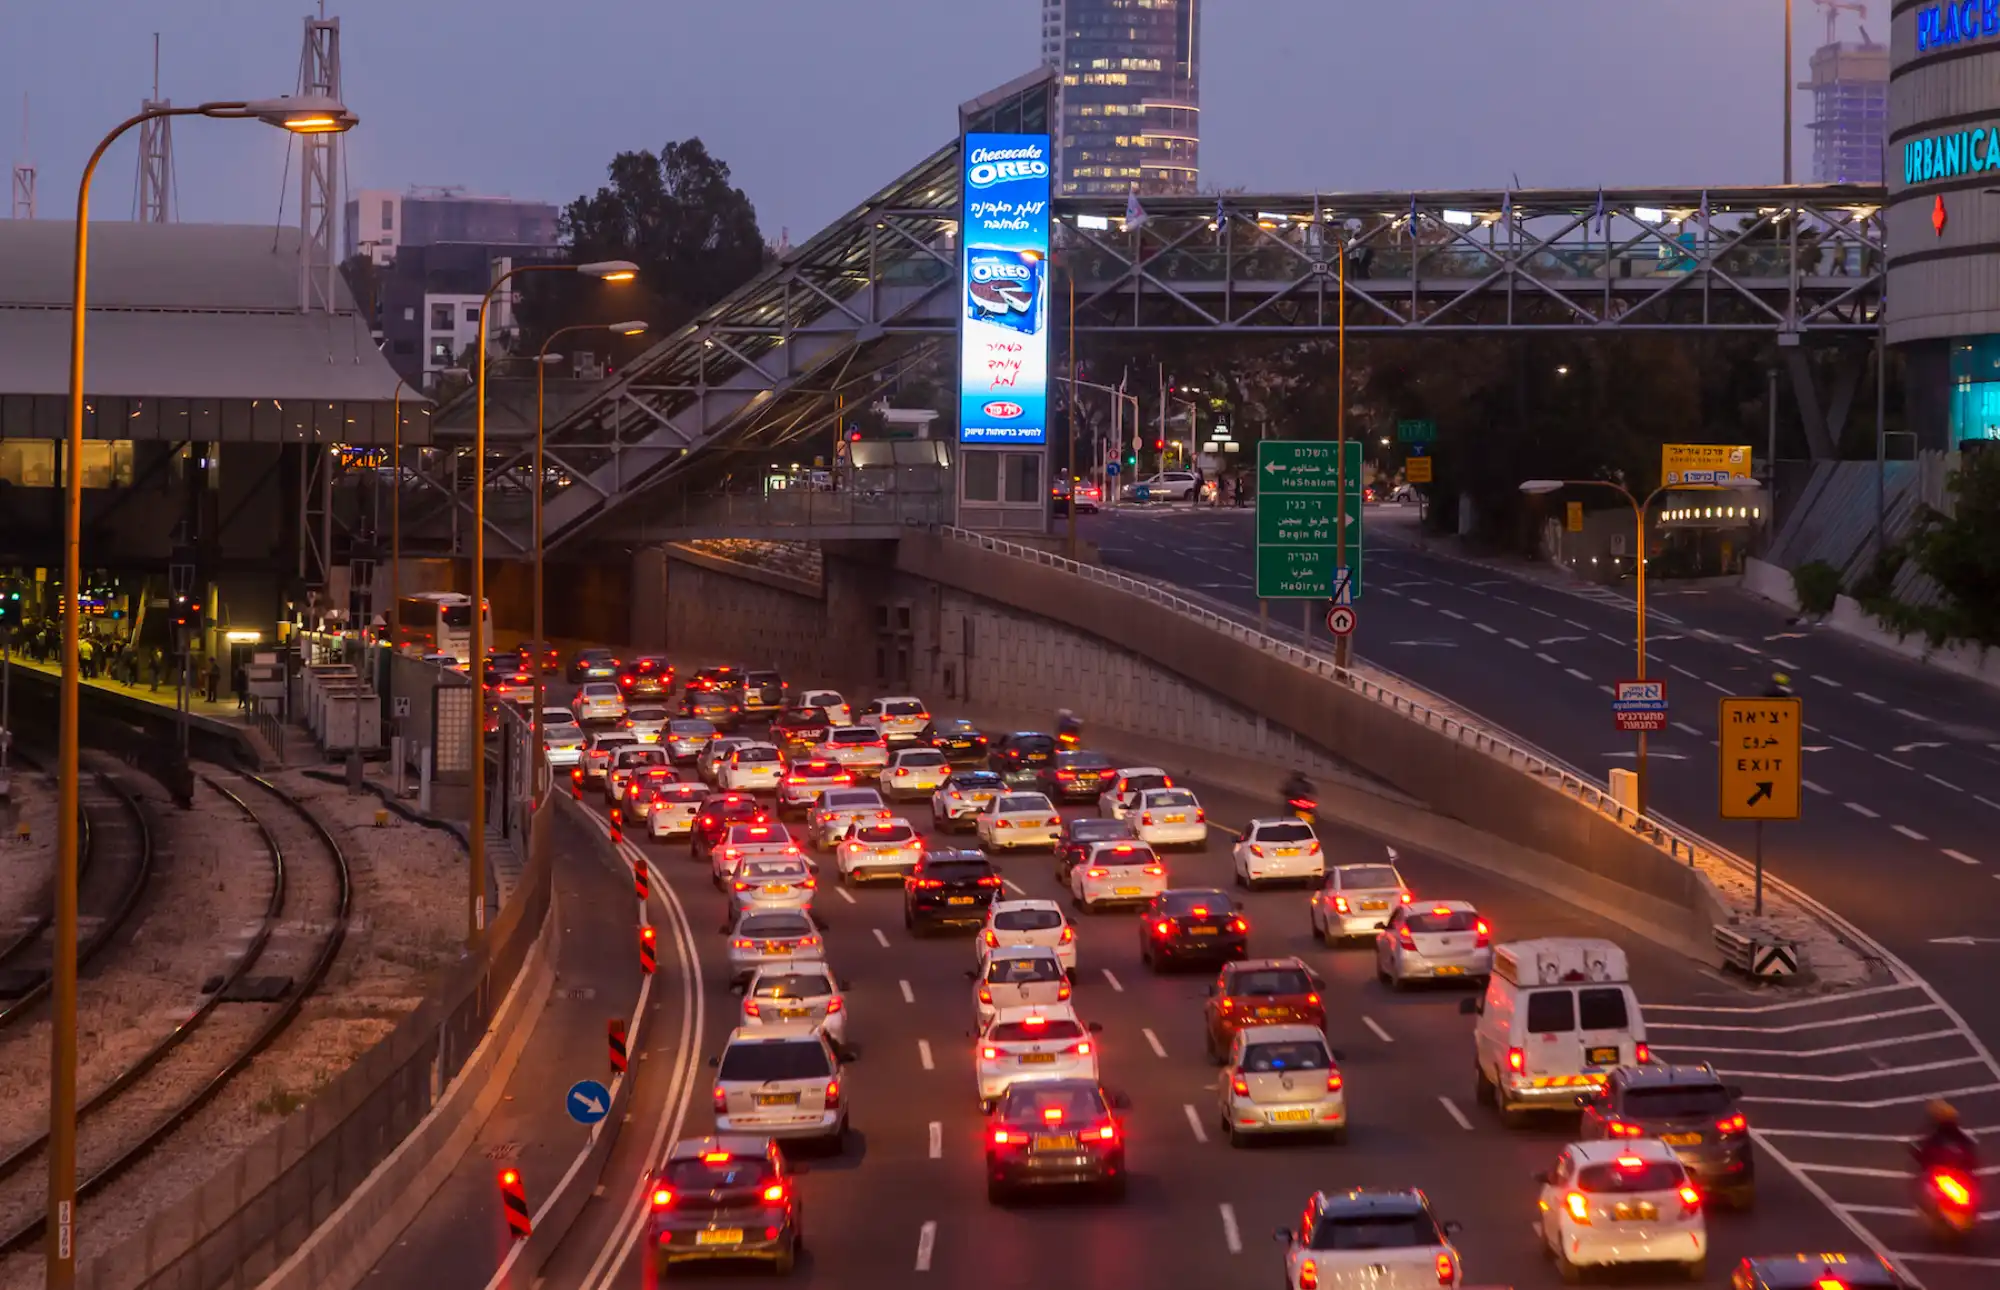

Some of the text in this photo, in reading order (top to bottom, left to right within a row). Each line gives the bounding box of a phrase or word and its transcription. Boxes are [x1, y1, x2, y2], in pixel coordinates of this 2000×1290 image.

[971, 144, 1042, 164] Cheesecake
[1905, 128, 2000, 185] URBANICA
[970, 160, 1047, 184] OREO
[971, 201, 1012, 218] הגבינה
[973, 264, 1029, 281] OREO
[986, 342, 1023, 352] במחיר
[1018, 428, 1041, 436] להשיג
[1295, 448, 1328, 458] השלום
[1282, 478, 1336, 487] HaShalom
[1286, 500, 1306, 510] בגין
[1279, 530, 1328, 540] Begin Rd
[1288, 552, 1319, 562] הקריה
[1281, 582, 1326, 591] HaQirya
[1733, 711, 1788, 723] יציאה
[1743, 734, 1779, 749] خروج
[1738, 759, 1782, 771] EXIT
